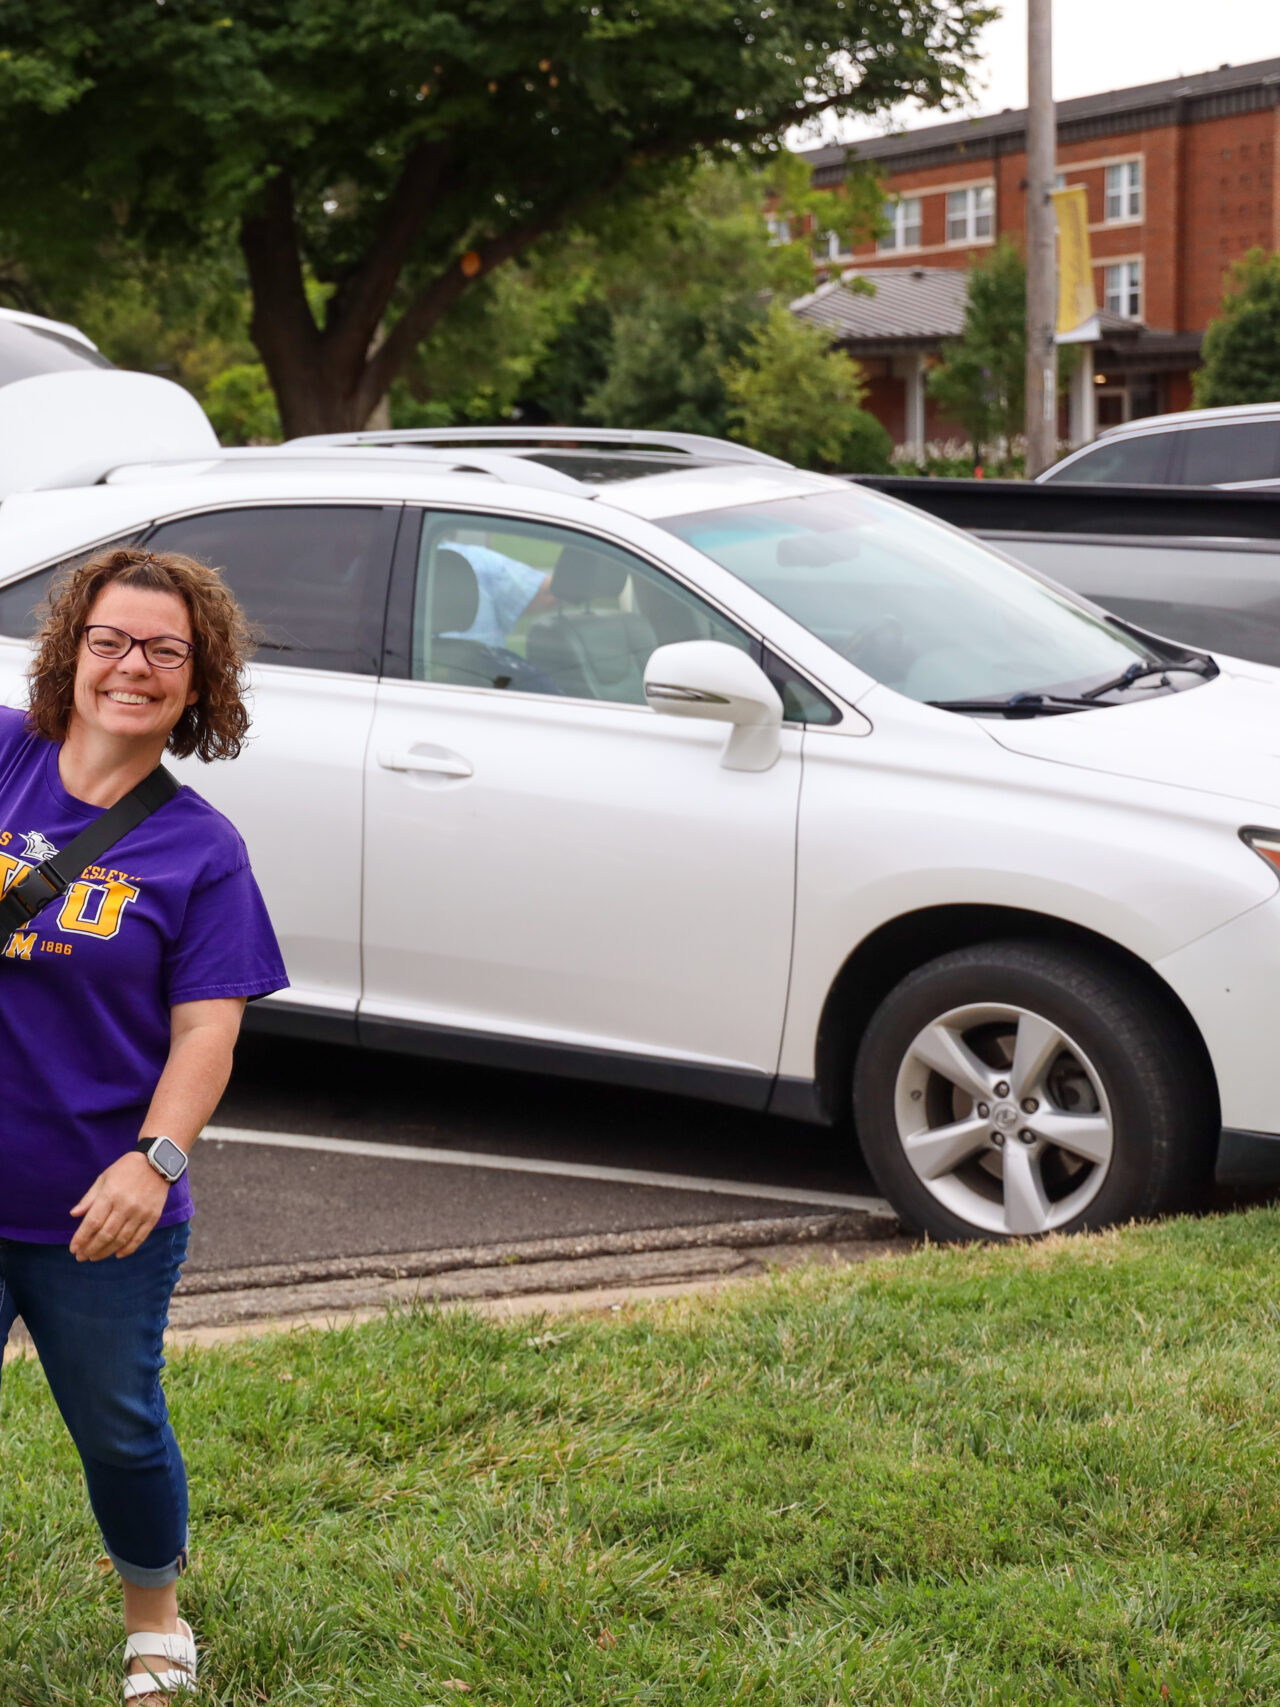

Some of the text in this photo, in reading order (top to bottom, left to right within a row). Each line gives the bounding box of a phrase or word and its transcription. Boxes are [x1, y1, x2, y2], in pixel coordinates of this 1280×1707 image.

[80, 864, 143, 882] ESLEY
[1, 931, 73, 960] M 1886
